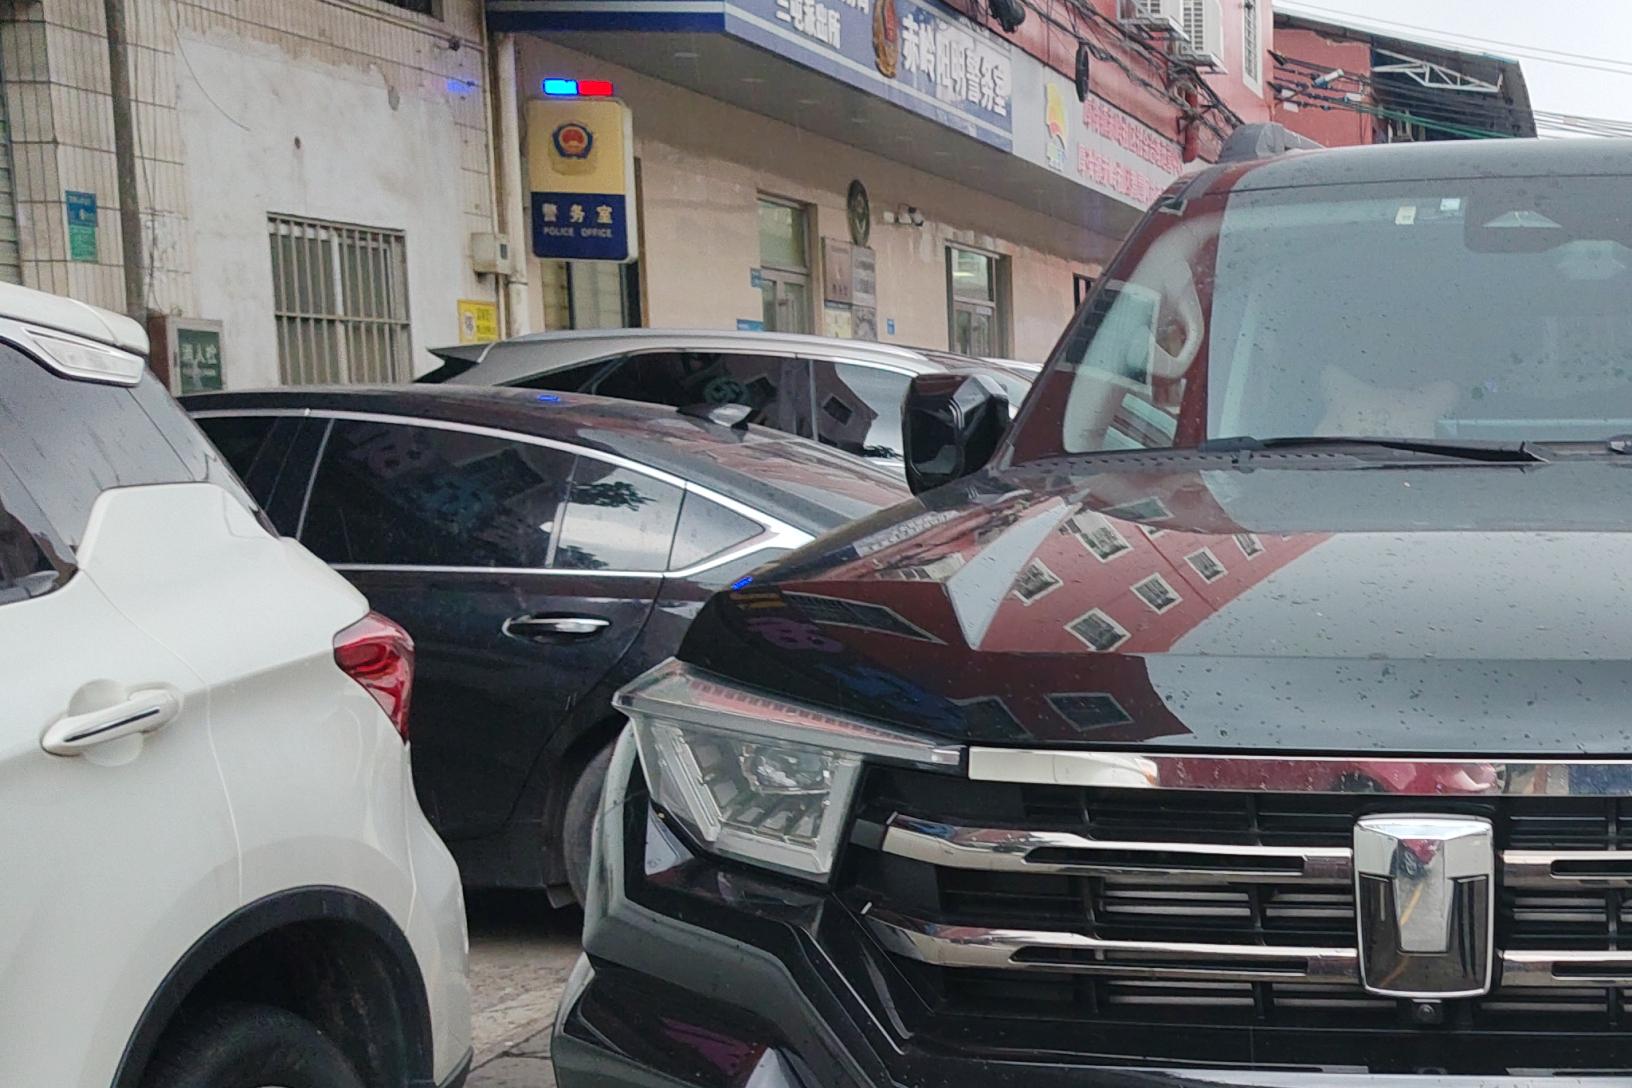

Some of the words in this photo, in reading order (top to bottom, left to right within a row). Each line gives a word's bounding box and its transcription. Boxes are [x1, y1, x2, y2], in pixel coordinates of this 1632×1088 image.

[542, 203, 613, 223] 警务室
[543, 226, 574, 237] POLICE
[580, 227, 613, 238] OFFICE
